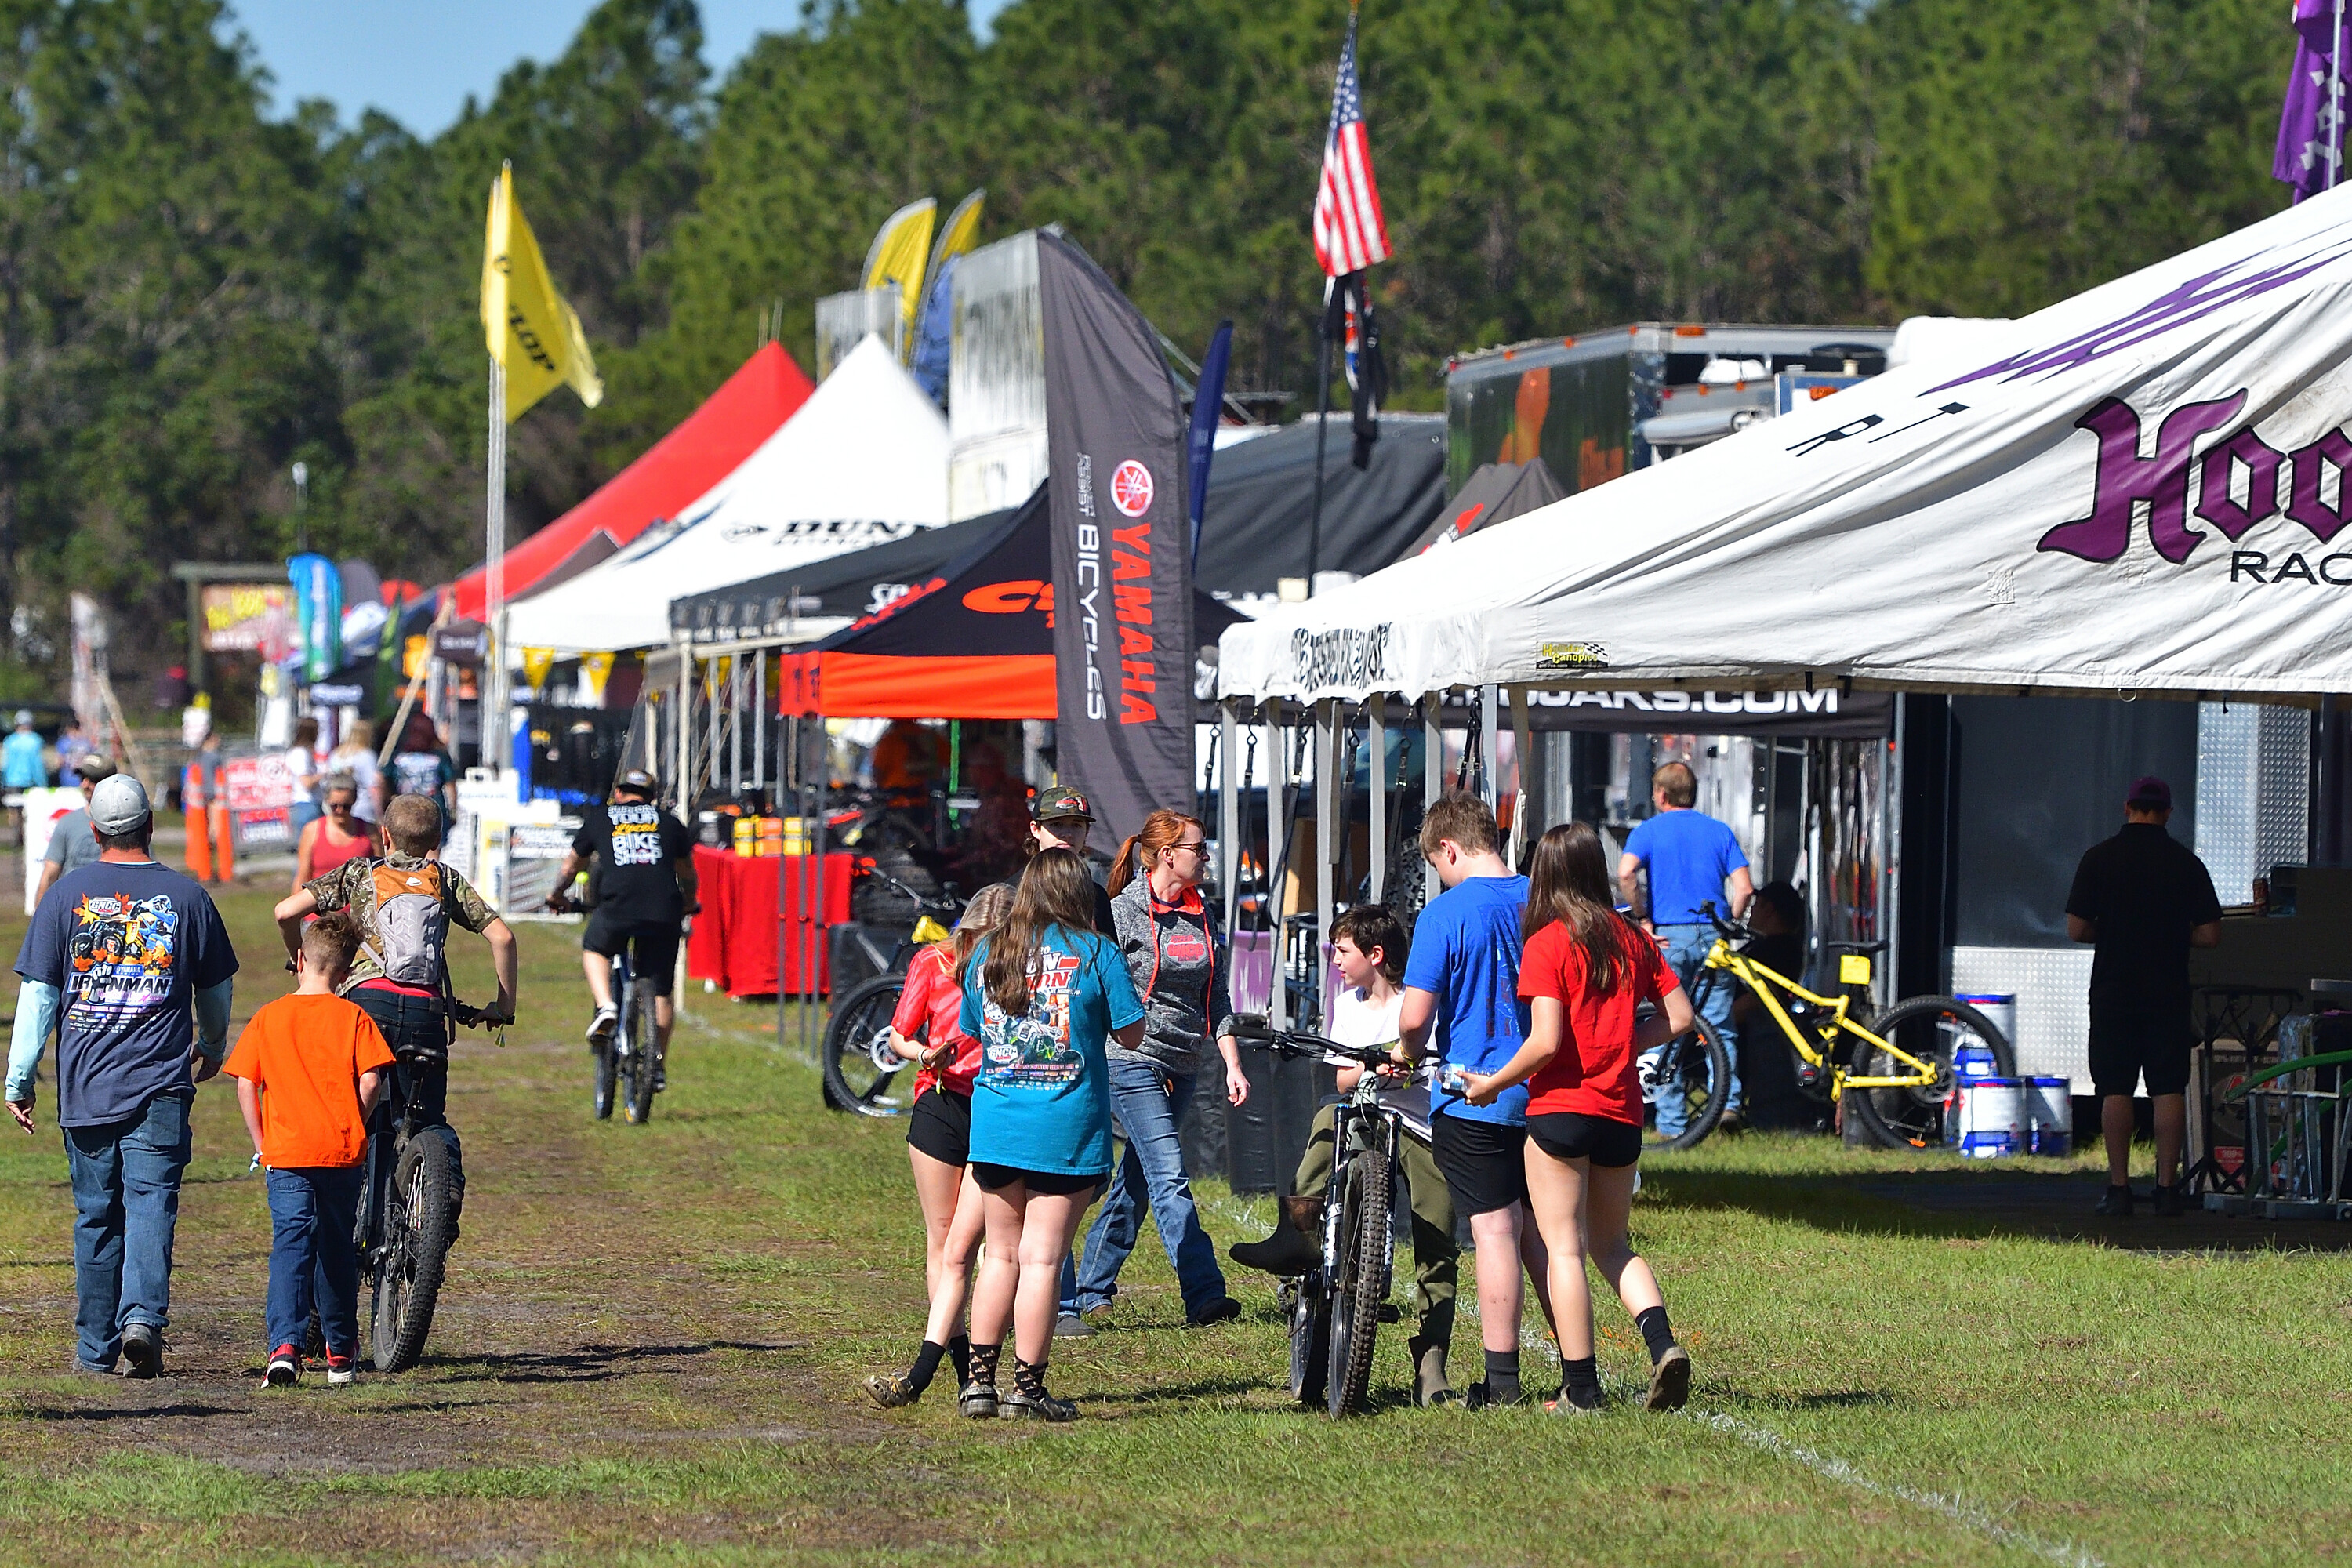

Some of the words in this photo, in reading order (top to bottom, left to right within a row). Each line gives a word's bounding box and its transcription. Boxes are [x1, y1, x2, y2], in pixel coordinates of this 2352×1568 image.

[1077, 524, 1108, 720] BICYCLES
[1112, 523, 1158, 724] YAMAHA
[608, 812, 660, 825] YOUR
[612, 833, 662, 851] BIKE
[90, 901, 120, 909] GNCC
[990, 1047, 1018, 1056] GNCC
